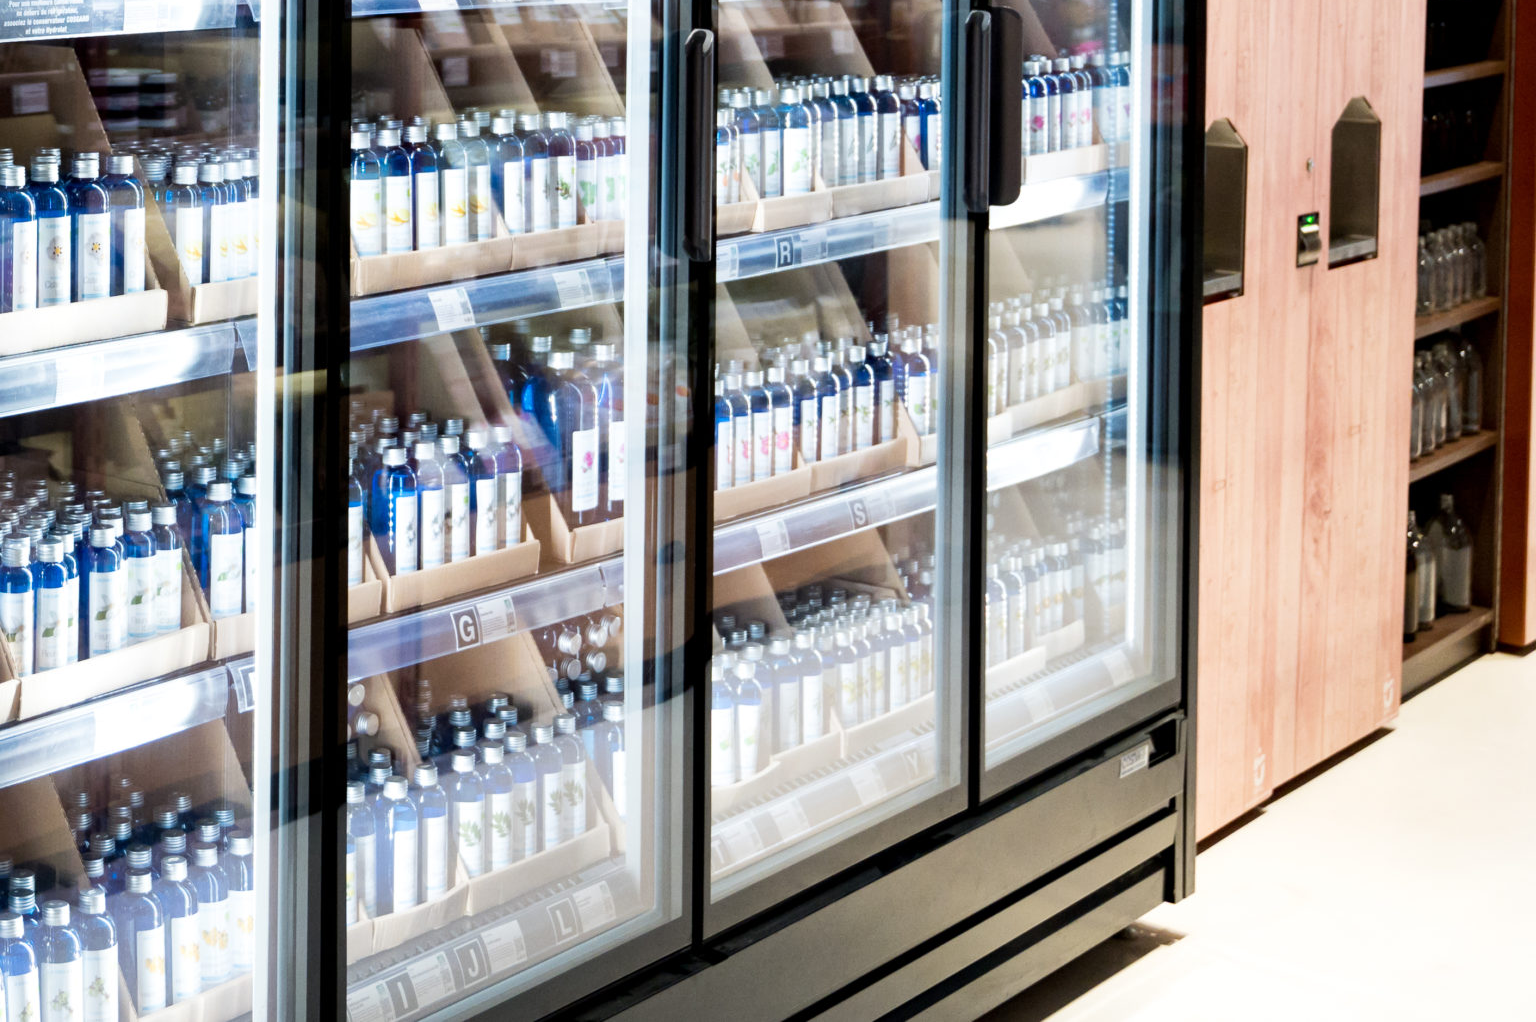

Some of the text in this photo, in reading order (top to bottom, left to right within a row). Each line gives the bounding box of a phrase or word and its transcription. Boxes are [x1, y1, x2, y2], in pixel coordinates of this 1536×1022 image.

[8, 0, 21, 8] Pour
[66, 14, 90, 23] COSGARD
[32, 27, 45, 35] votre
[779, 240, 792, 265] R
[853, 502, 866, 525] S
[458, 614, 476, 642] G
[555, 909, 572, 936] L
[466, 953, 480, 978] J
